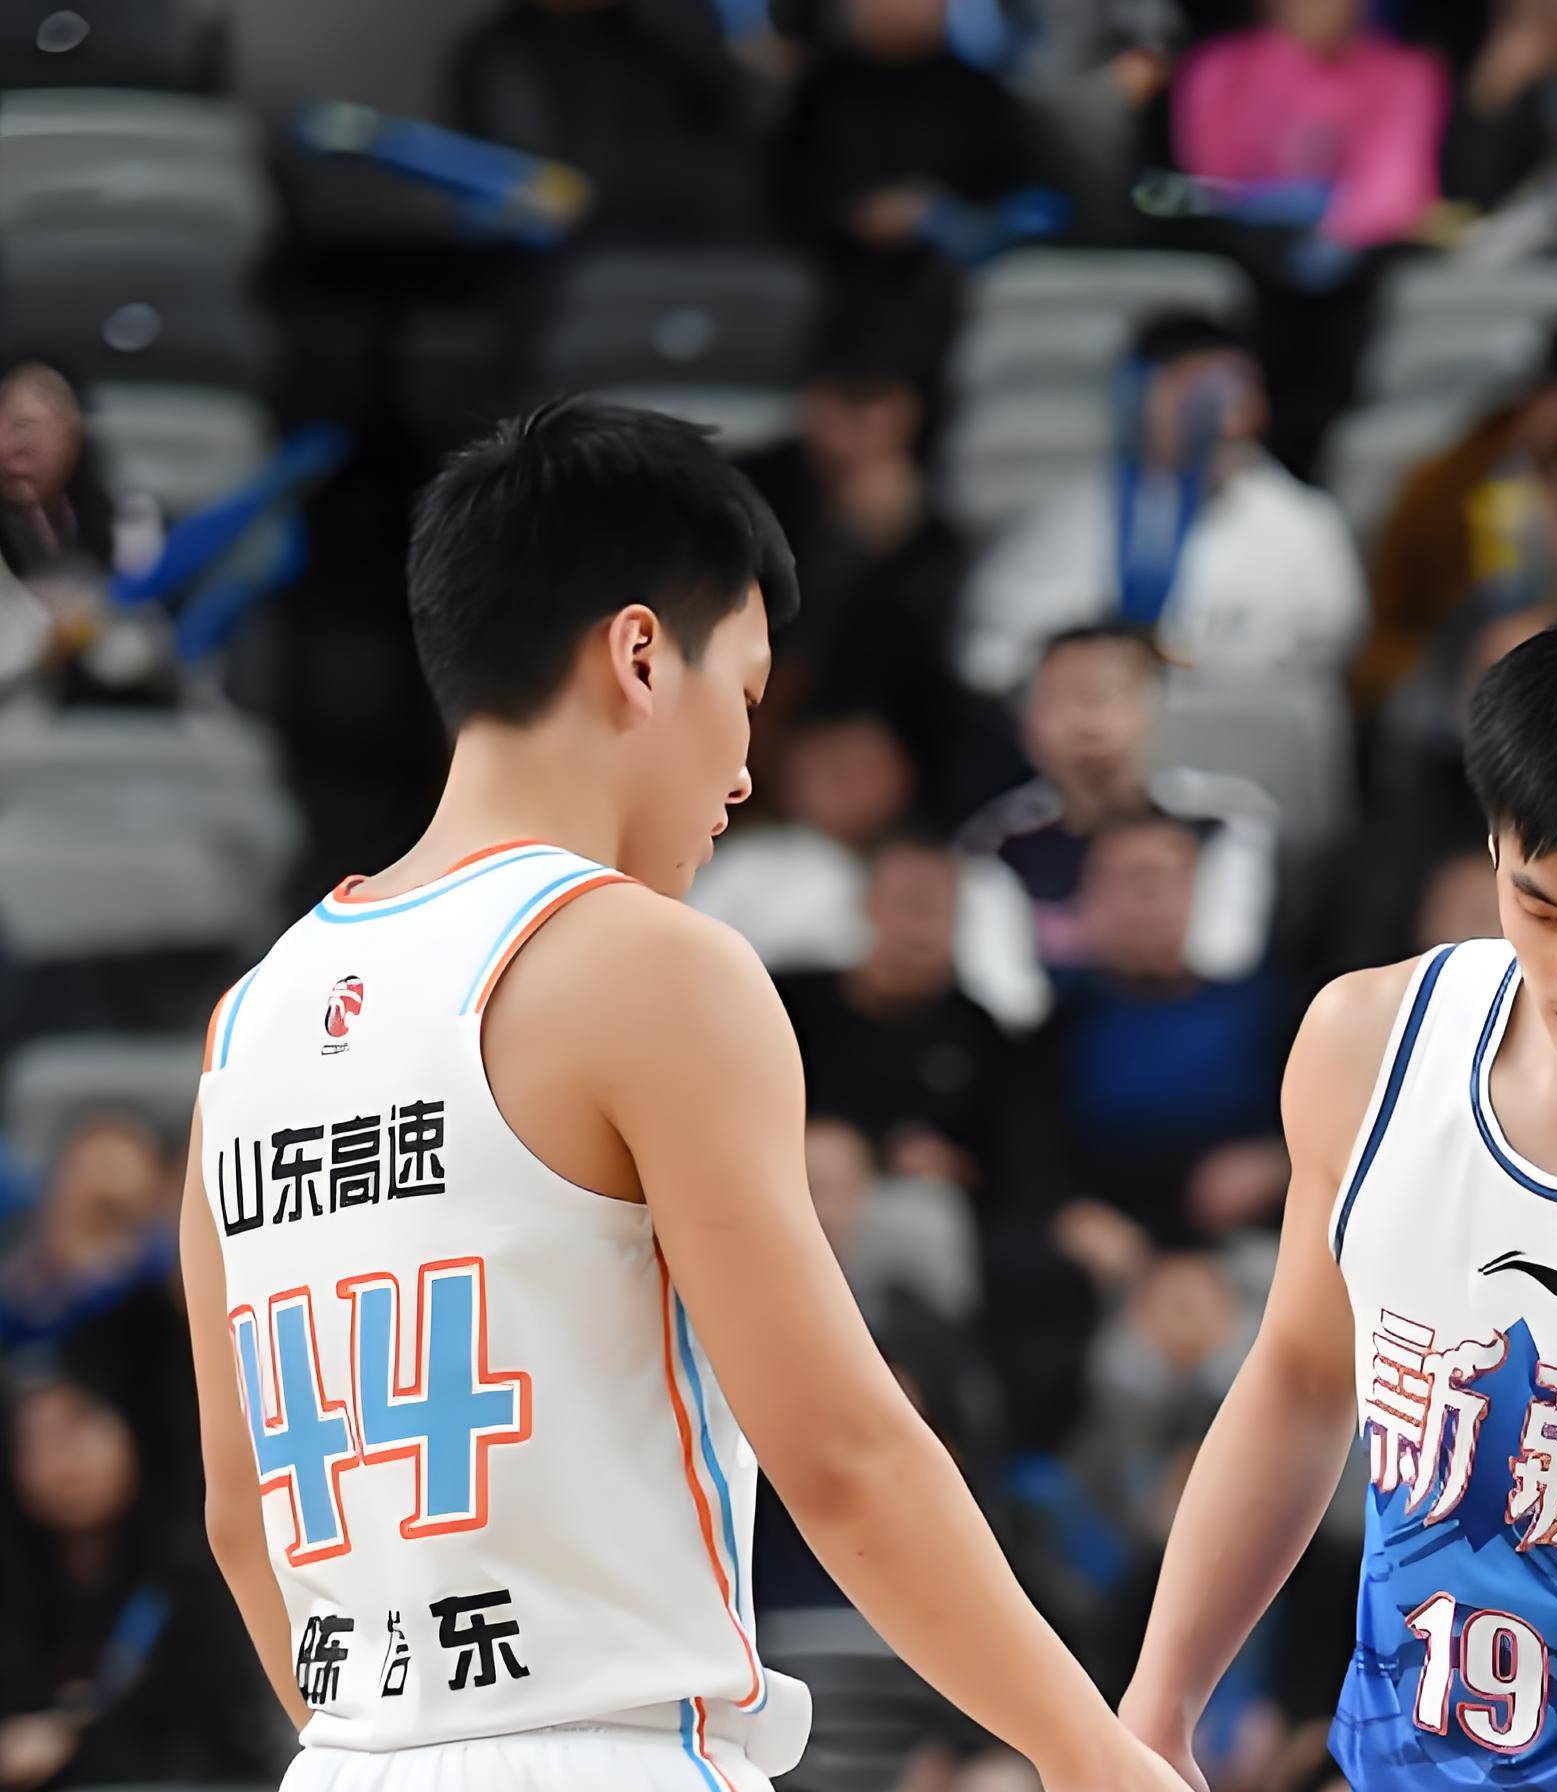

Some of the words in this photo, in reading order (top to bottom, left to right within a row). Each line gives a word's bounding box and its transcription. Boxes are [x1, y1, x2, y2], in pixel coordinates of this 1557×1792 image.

[218, 1100, 446, 1237] 山东高速
[229, 1256, 533, 1567] 44
[1404, 1590, 1550, 1754] 19
